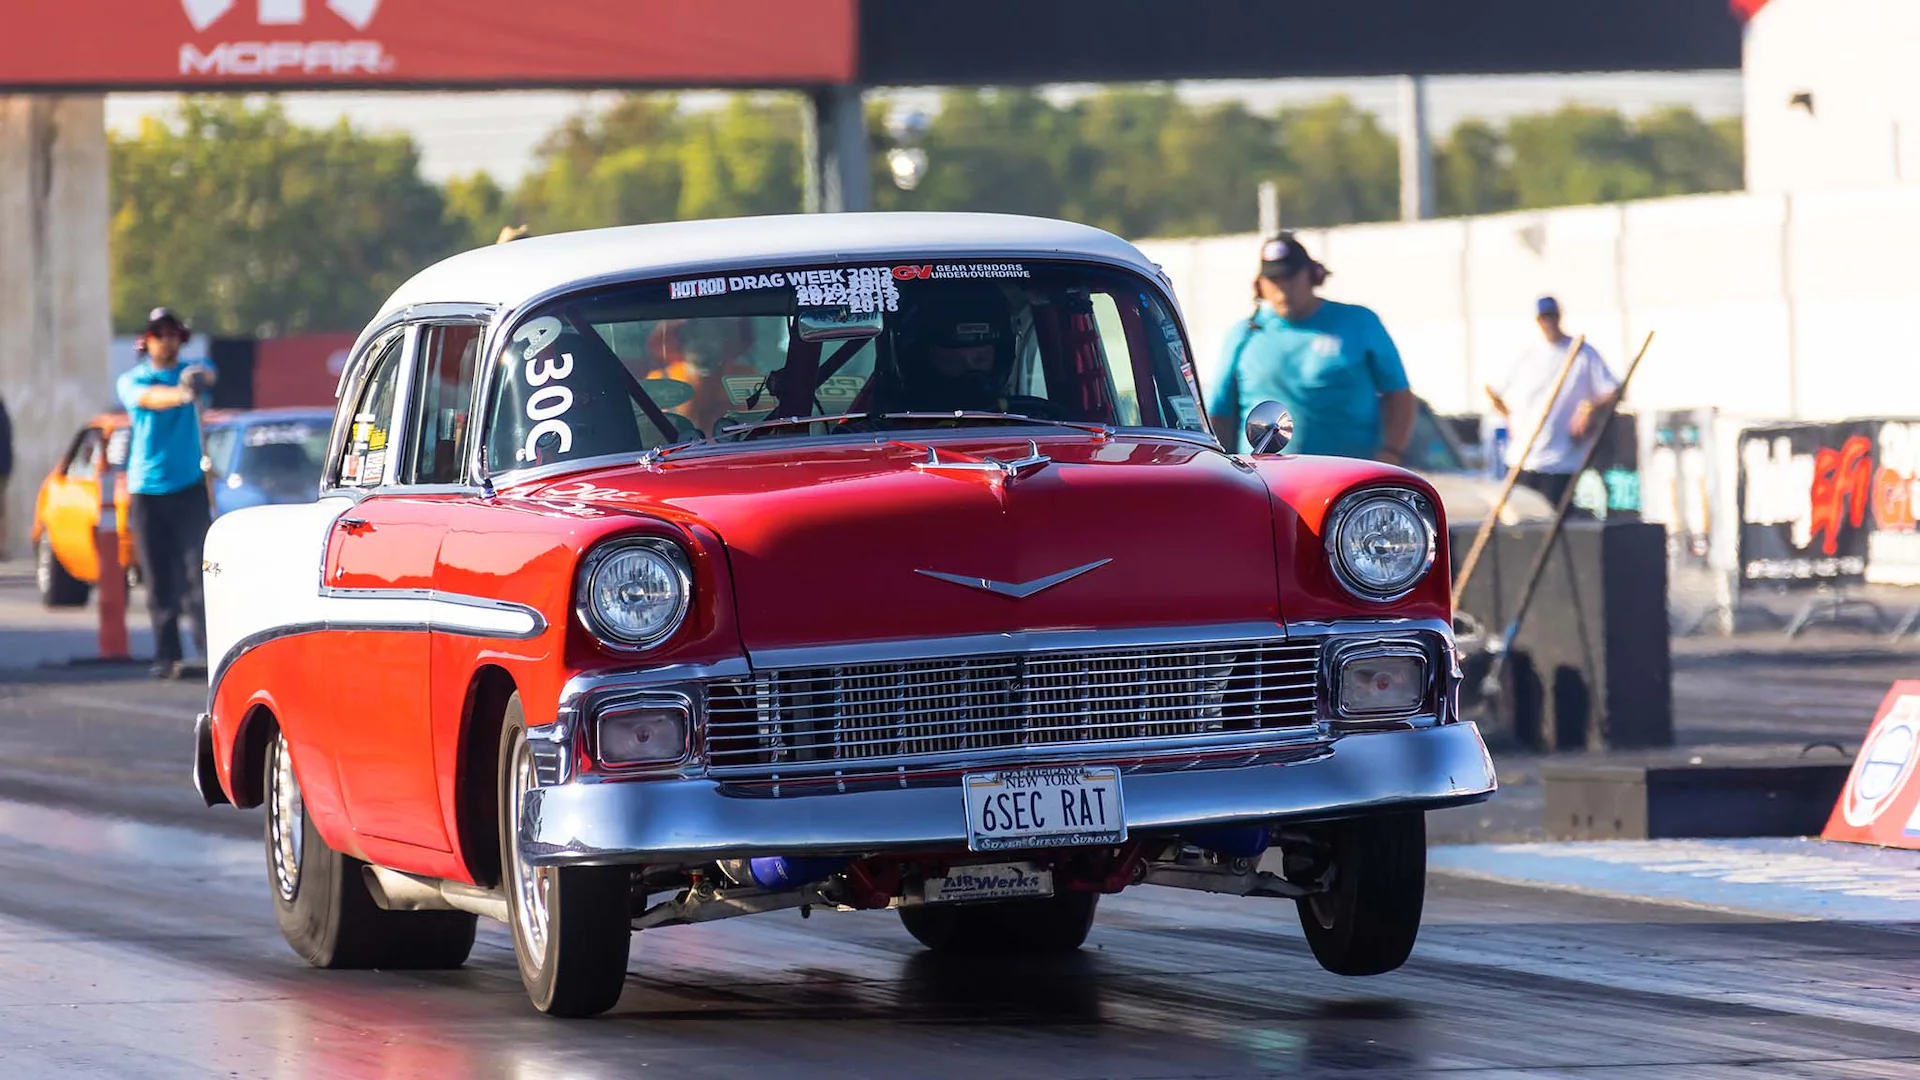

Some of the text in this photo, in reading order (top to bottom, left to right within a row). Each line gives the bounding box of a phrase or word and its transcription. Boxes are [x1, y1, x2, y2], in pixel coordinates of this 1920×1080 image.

[179, 40, 382, 75] MOPAR
[936, 264, 1023, 272] GEAR VENDORS
[670, 280, 698, 300] HOT
[698, 277, 727, 296] ROD
[729, 271, 785, 292] DRAG
[786, 269, 846, 286] WEEK
[525, 352, 574, 462] 30C
[1002, 767, 1082, 778] PARTICIPANT
[1006, 775, 1081, 789] NEW YORK
[983, 787, 1106, 832] 6SEC RAT
